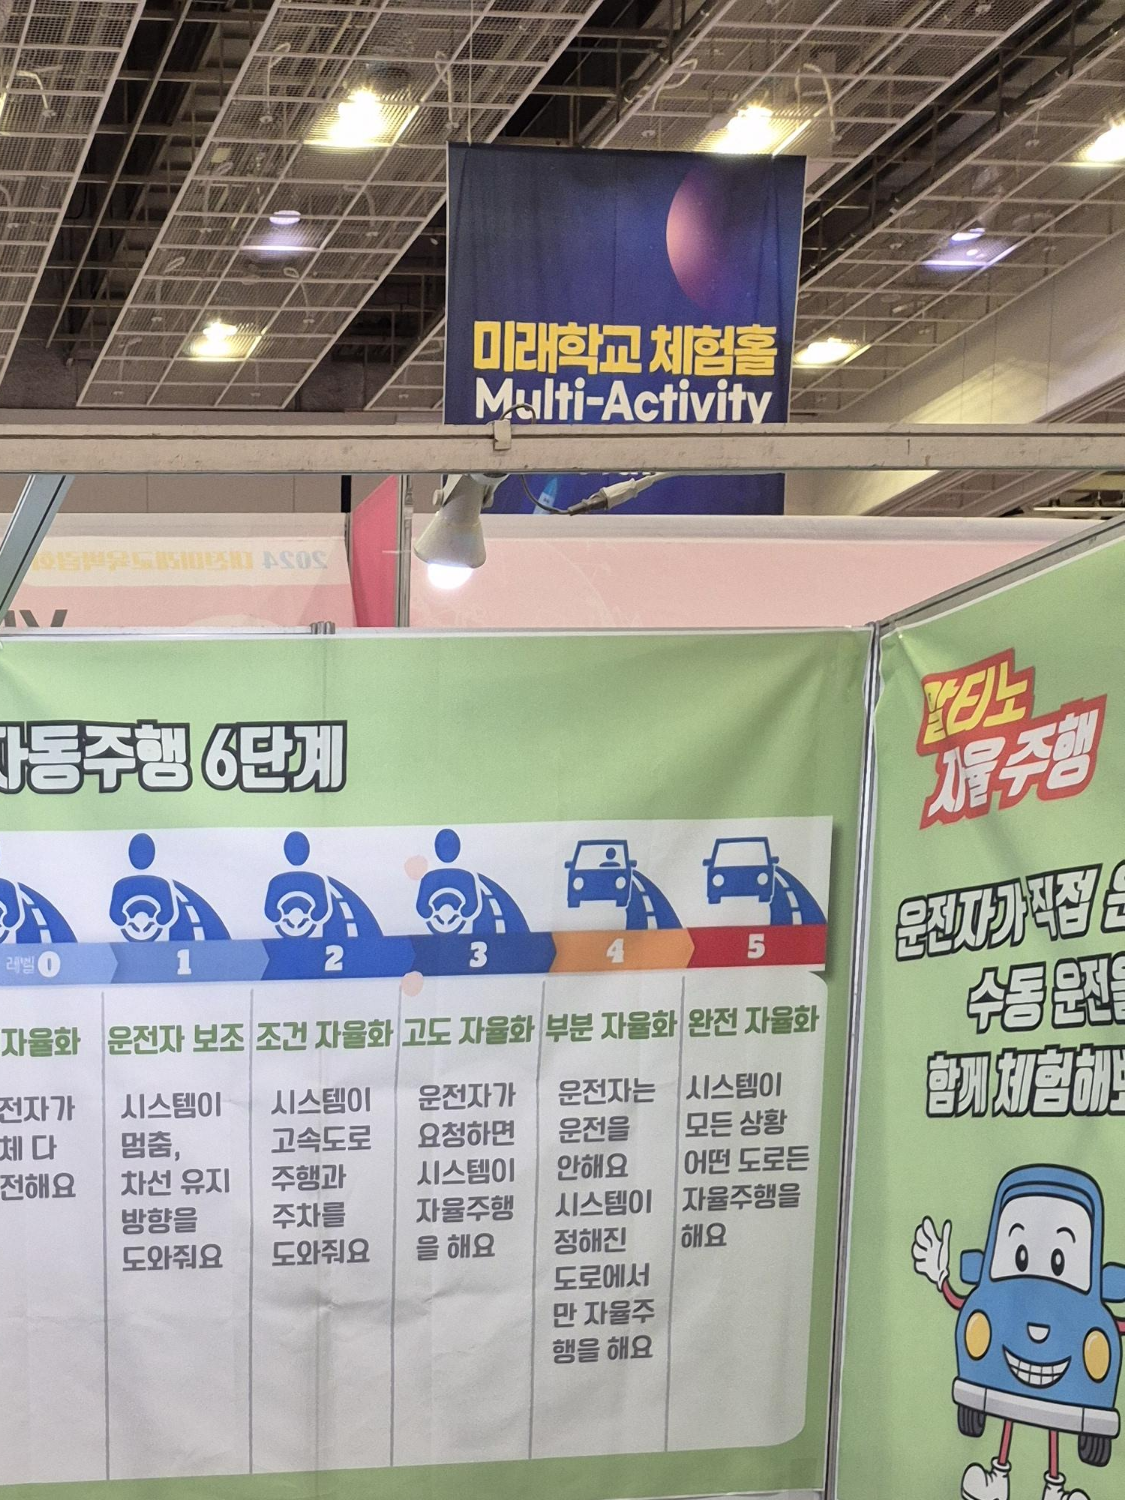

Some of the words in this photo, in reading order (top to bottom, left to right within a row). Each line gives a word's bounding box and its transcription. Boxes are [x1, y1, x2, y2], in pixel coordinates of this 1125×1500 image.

[473, 320, 643, 374] 미래학교
[650, 323, 778, 377] 체험홀
[475, 377, 773, 424] Multi-Activity
[923, 660, 1029, 745] 알티노
[202, 720, 348, 793] 6단계
[896, 878, 1026, 961] 운전자가
[1026, 864, 1102, 940] 직접
[177, 948, 192, 975] 1
[325, 945, 344, 972] 2
[468, 941, 488, 968] 3
[605, 938, 625, 964] 4
[747, 933, 766, 960] 5
[967, 962, 1046, 1034] 수동
[256, 1020, 307, 1051] 조건
[315, 1019, 394, 1050] 자율화
[401, 1017, 452, 1047] 고도
[458, 1012, 535, 1044] 자율화
[545, 1012, 594, 1042] 부분
[601, 1009, 678, 1040] 자율화
[688, 1007, 738, 1037] 완전
[744, 1004, 820, 1035] 자율화
[107, 1024, 185, 1055] 운전자
[193, 1022, 244, 1052] 보조
[418, 1082, 516, 1111] 운전자가
[558, 1077, 656, 1107] 운전자는
[685, 1071, 782, 1101] 시스템이
[926, 1051, 991, 1118] 함께
[120, 1091, 222, 1121] 시스템이
[271, 1086, 372, 1117] 시스템이
[418, 1120, 516, 1150] 요청하면
[558, 1115, 630, 1144] 운전을
[685, 1110, 732, 1139] 모든
[740, 1108, 787, 1137] 상황
[31, 1134, 57, 1161] 다
[121, 1130, 180, 1161] 멈춤,
[271, 1125, 372, 1154] 고속도로
[417, 1157, 515, 1186] 시스템이
[557, 1152, 629, 1182] 안해요
[684, 1148, 731, 1176] 어떤
[737, 1145, 810, 1174] 도로든
[120, 1169, 172, 1197] 차선
[180, 1167, 231, 1195] 유지
[271, 1164, 347, 1192] 주행과
[415, 1195, 514, 1224] 자율주행
[555, 1188, 653, 1218] 시스템이
[681, 1182, 801, 1214] 자율주행을
[121, 1206, 198, 1236] 방향을
[272, 1201, 346, 1230] 주차를
[416, 1235, 439, 1261] 을
[447, 1233, 496, 1260] 해요
[554, 1227, 626, 1256] 정해진
[681, 1222, 727, 1249] 해요
[122, 1243, 223, 1272] 도와줘요
[271, 1238, 370, 1267] 도와줘요
[554, 1263, 650, 1292] 도로에서
[553, 1300, 577, 1329] 만
[583, 1298, 655, 1327] 자율주
[552, 1337, 600, 1364] 행을
[607, 1335, 653, 1361] 해요
